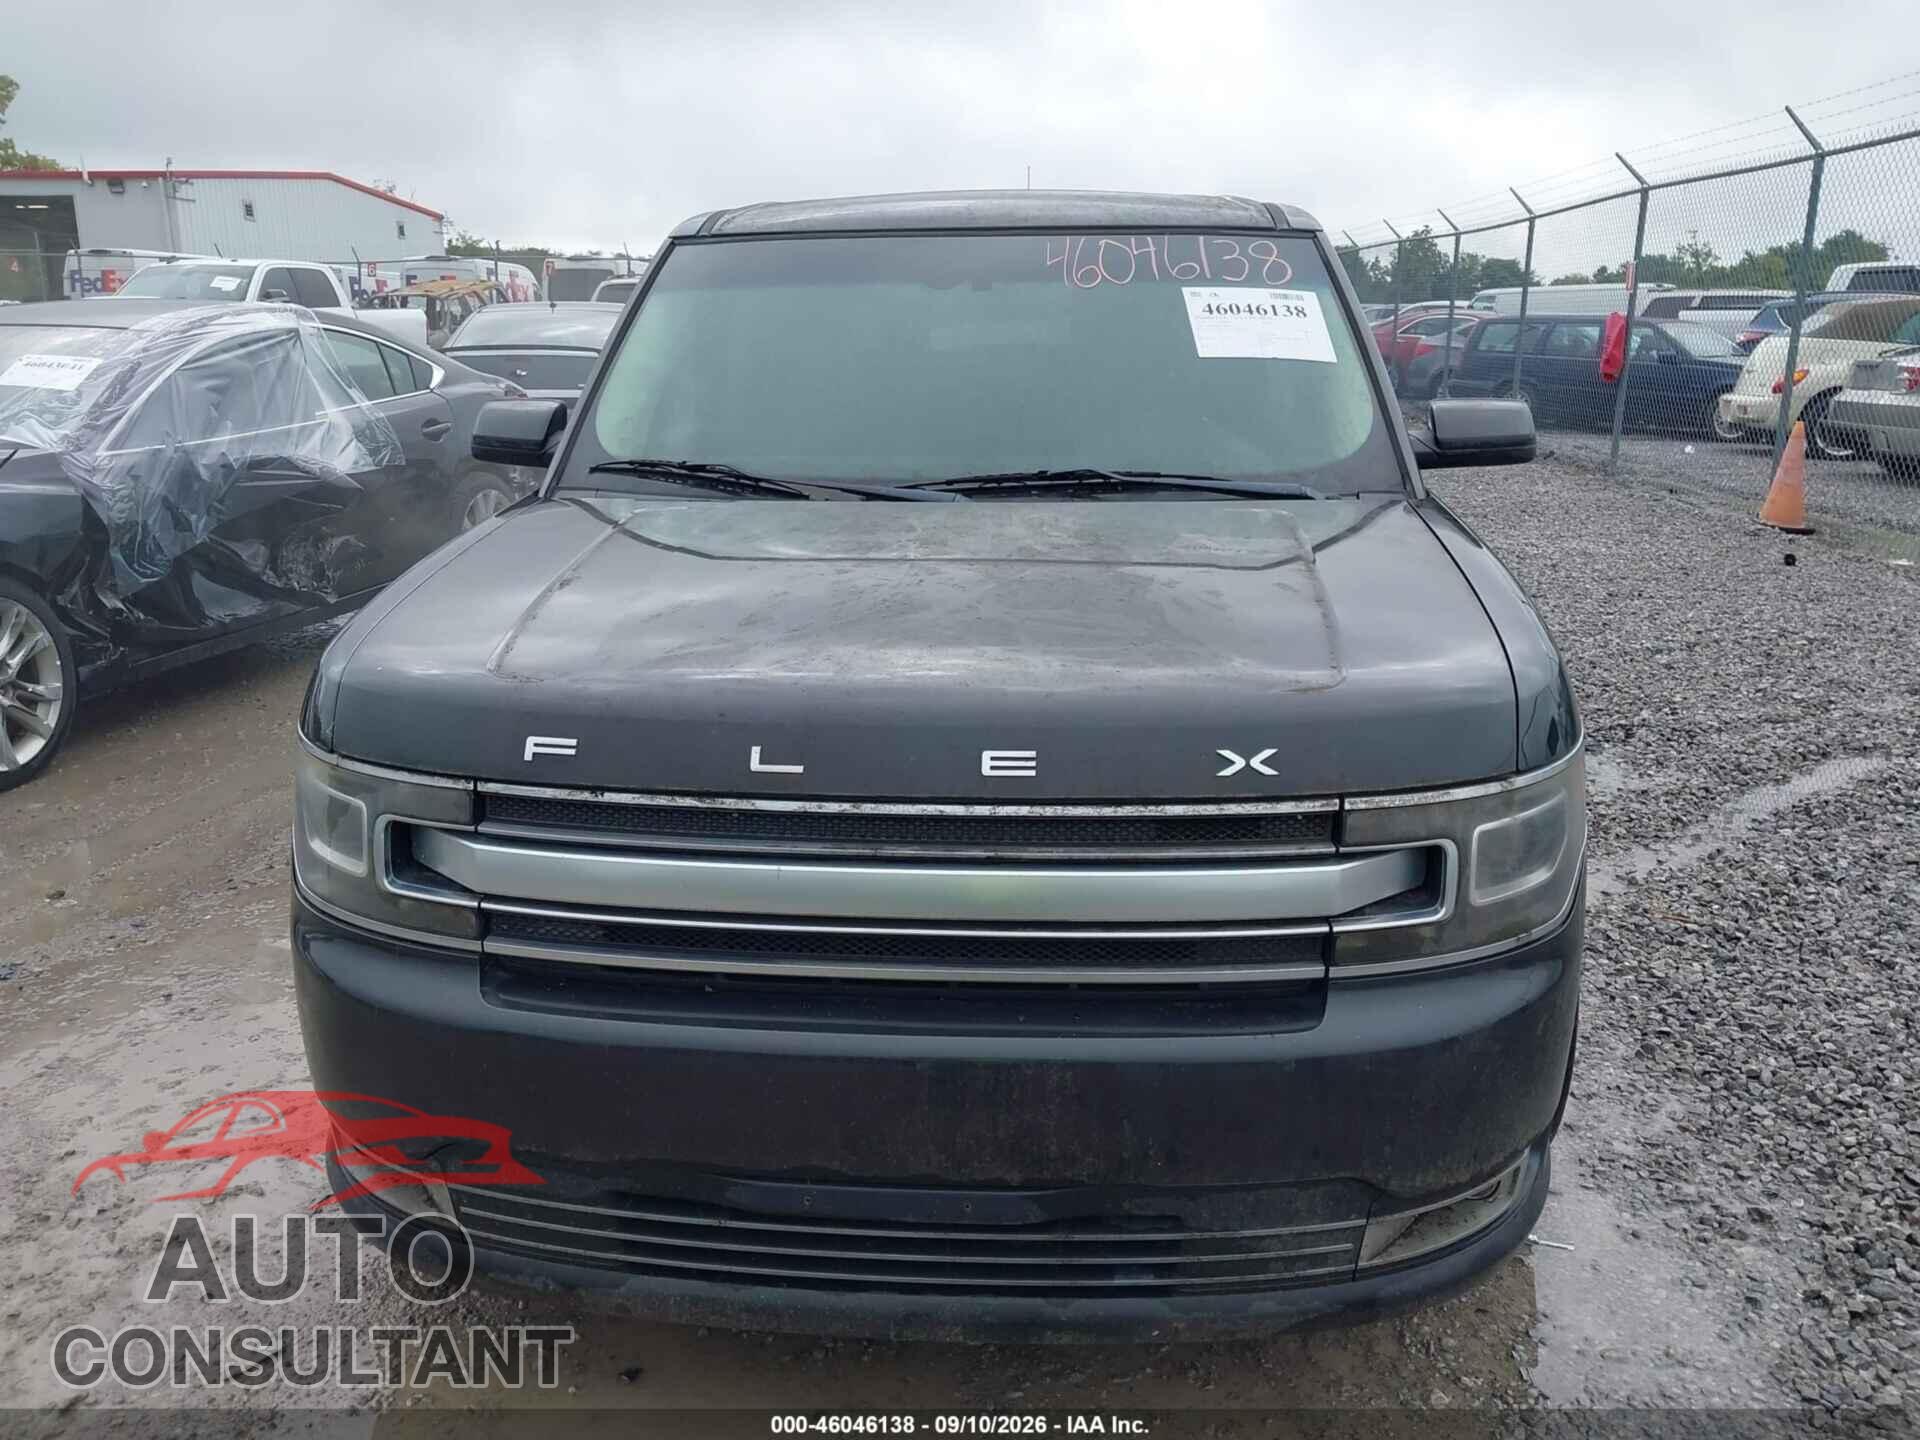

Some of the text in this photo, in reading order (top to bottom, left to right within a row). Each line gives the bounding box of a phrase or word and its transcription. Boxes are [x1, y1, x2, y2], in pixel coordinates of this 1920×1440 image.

[1046, 235, 1293, 288] 46046138
[368, 263, 376, 277] 6
[1201, 302, 1308, 318] 46046138
